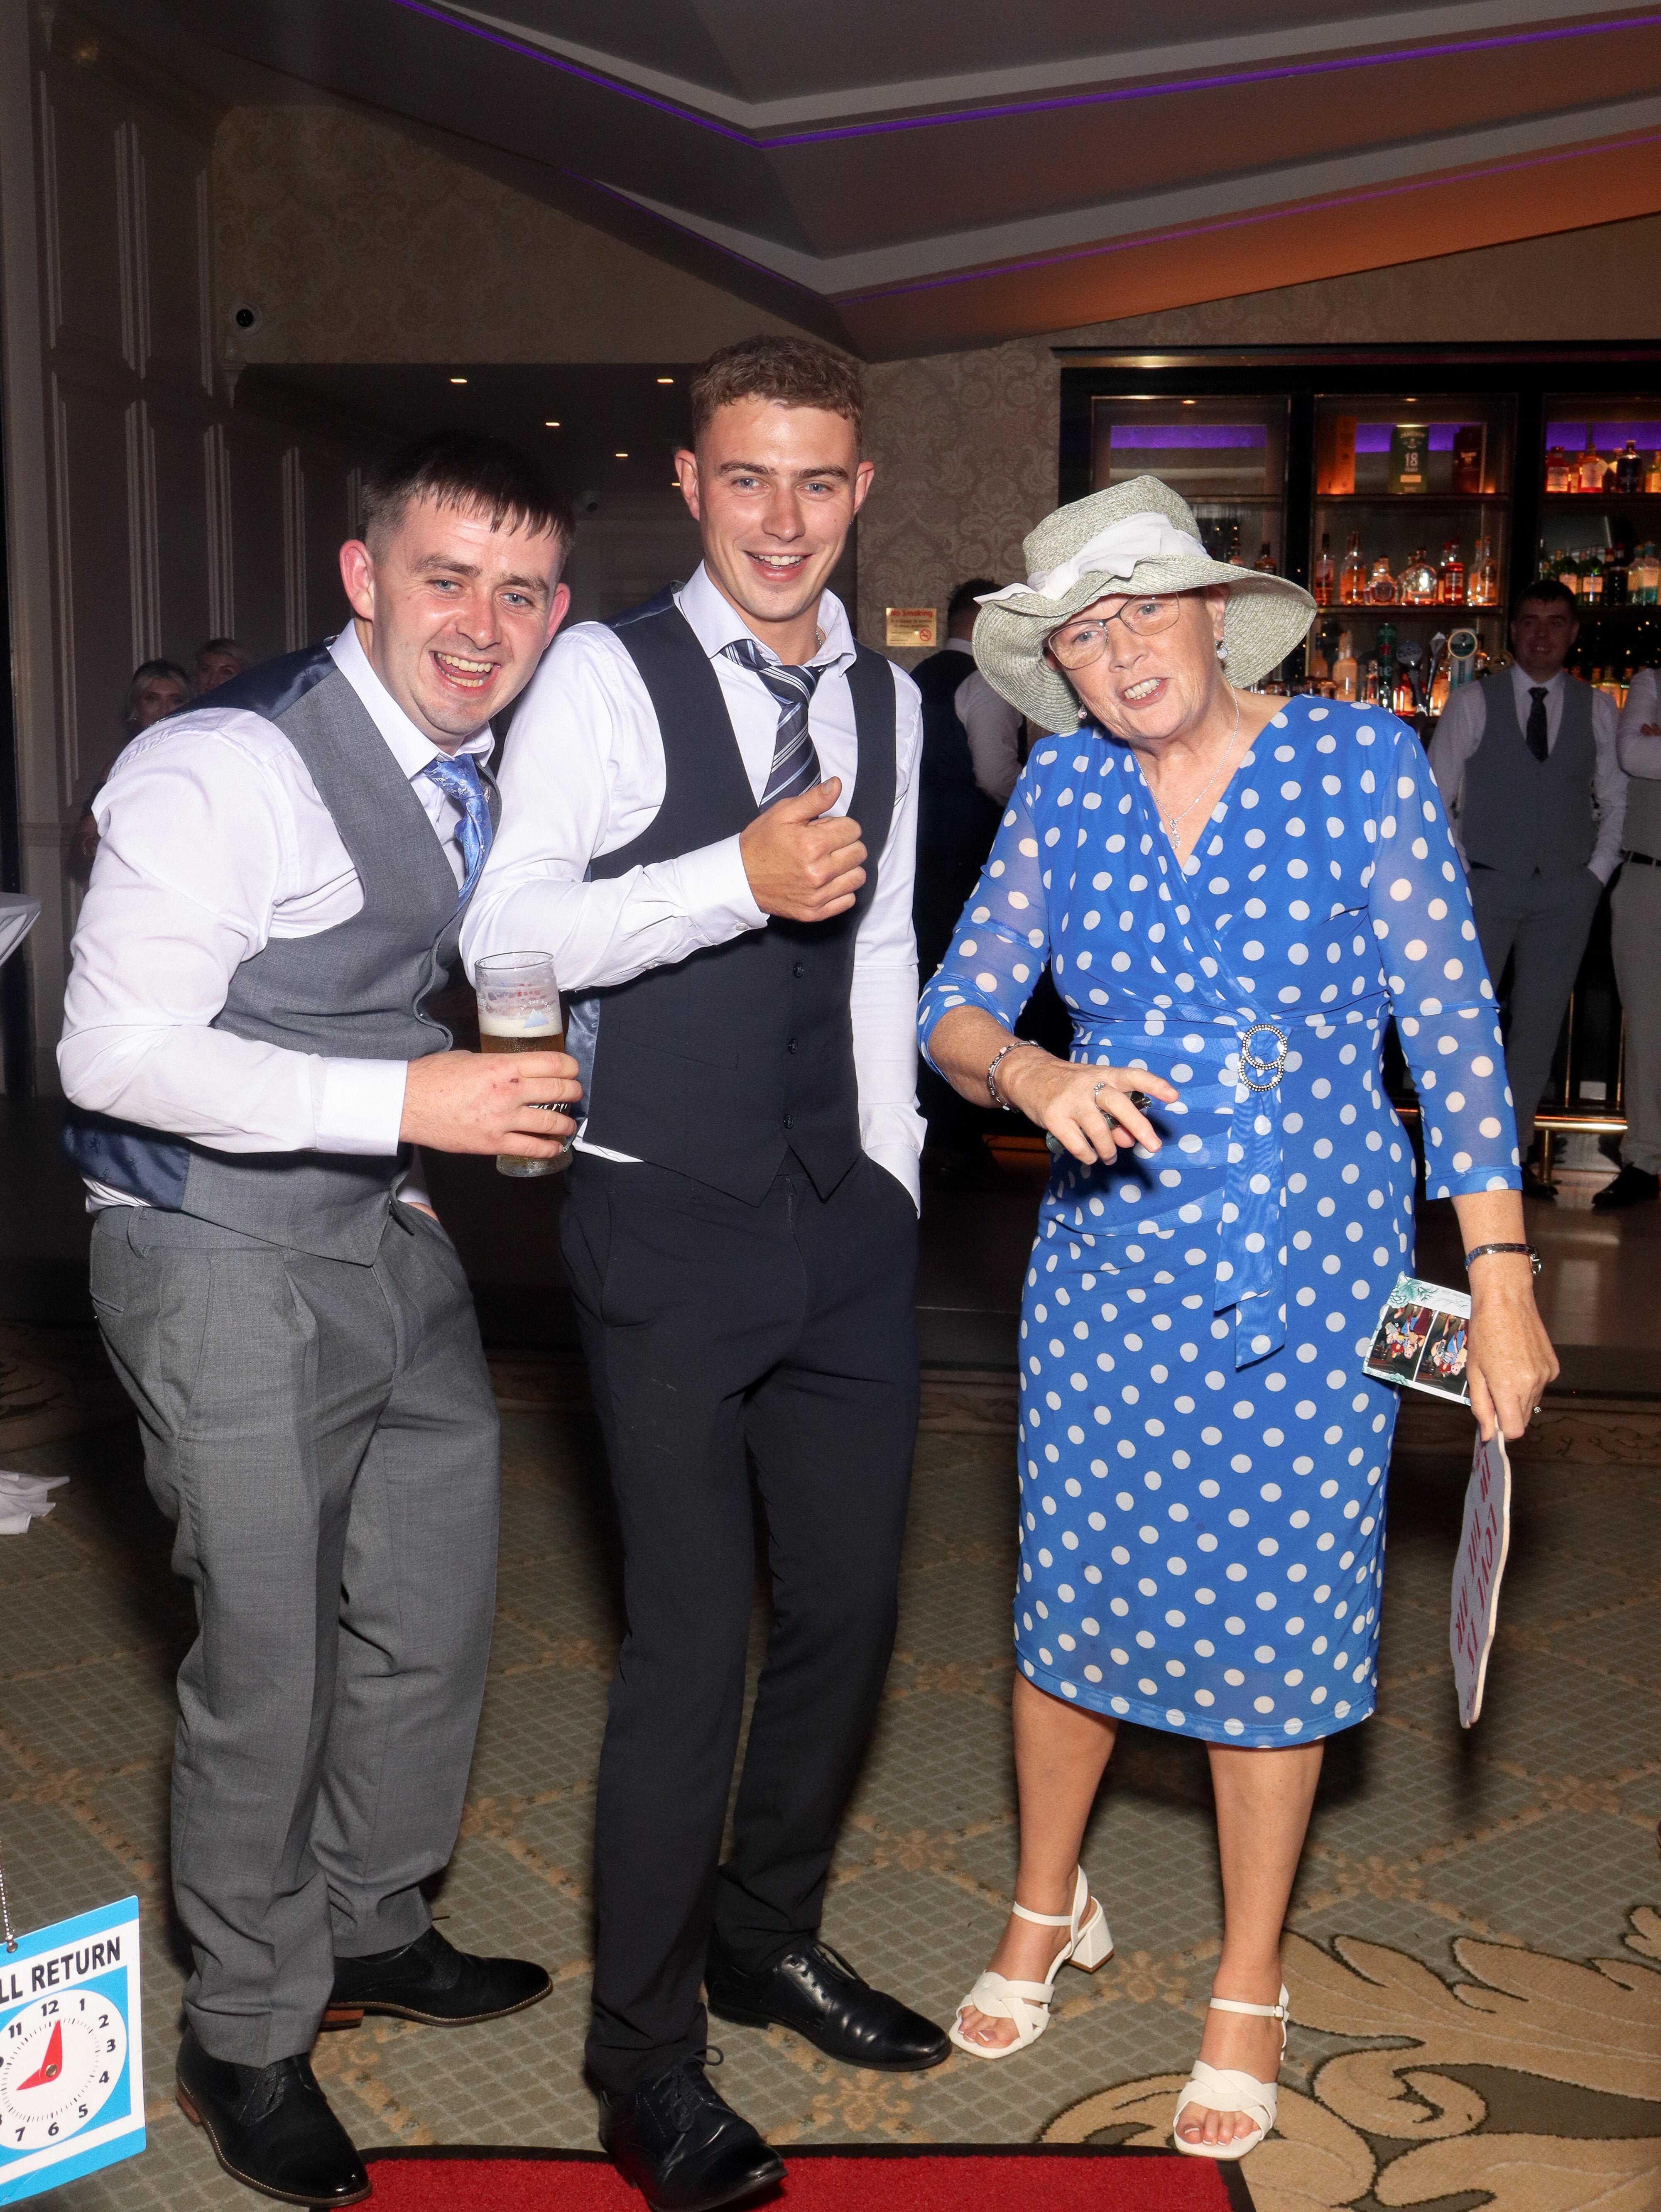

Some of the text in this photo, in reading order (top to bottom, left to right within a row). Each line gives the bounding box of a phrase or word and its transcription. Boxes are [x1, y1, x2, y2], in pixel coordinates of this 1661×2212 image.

[1405, 452, 1418, 467] 18
[902, 609, 933, 618] Smoking
[1476, 1502, 1497, 1624] LOVE
[32, 1936, 120, 1992] RETURN
[42, 2000, 59, 2016] 12
[79, 1998, 86, 2011] 1
[98, 2014, 109, 2028] 2
[8, 2022, 22, 2038] 11
[107, 2039, 116, 2053] 3
[99, 2070, 110, 2083] 4
[78, 2103, 88, 2118] 5
[15, 2126, 25, 2142] 7
[48, 2122, 59, 2136] 6
